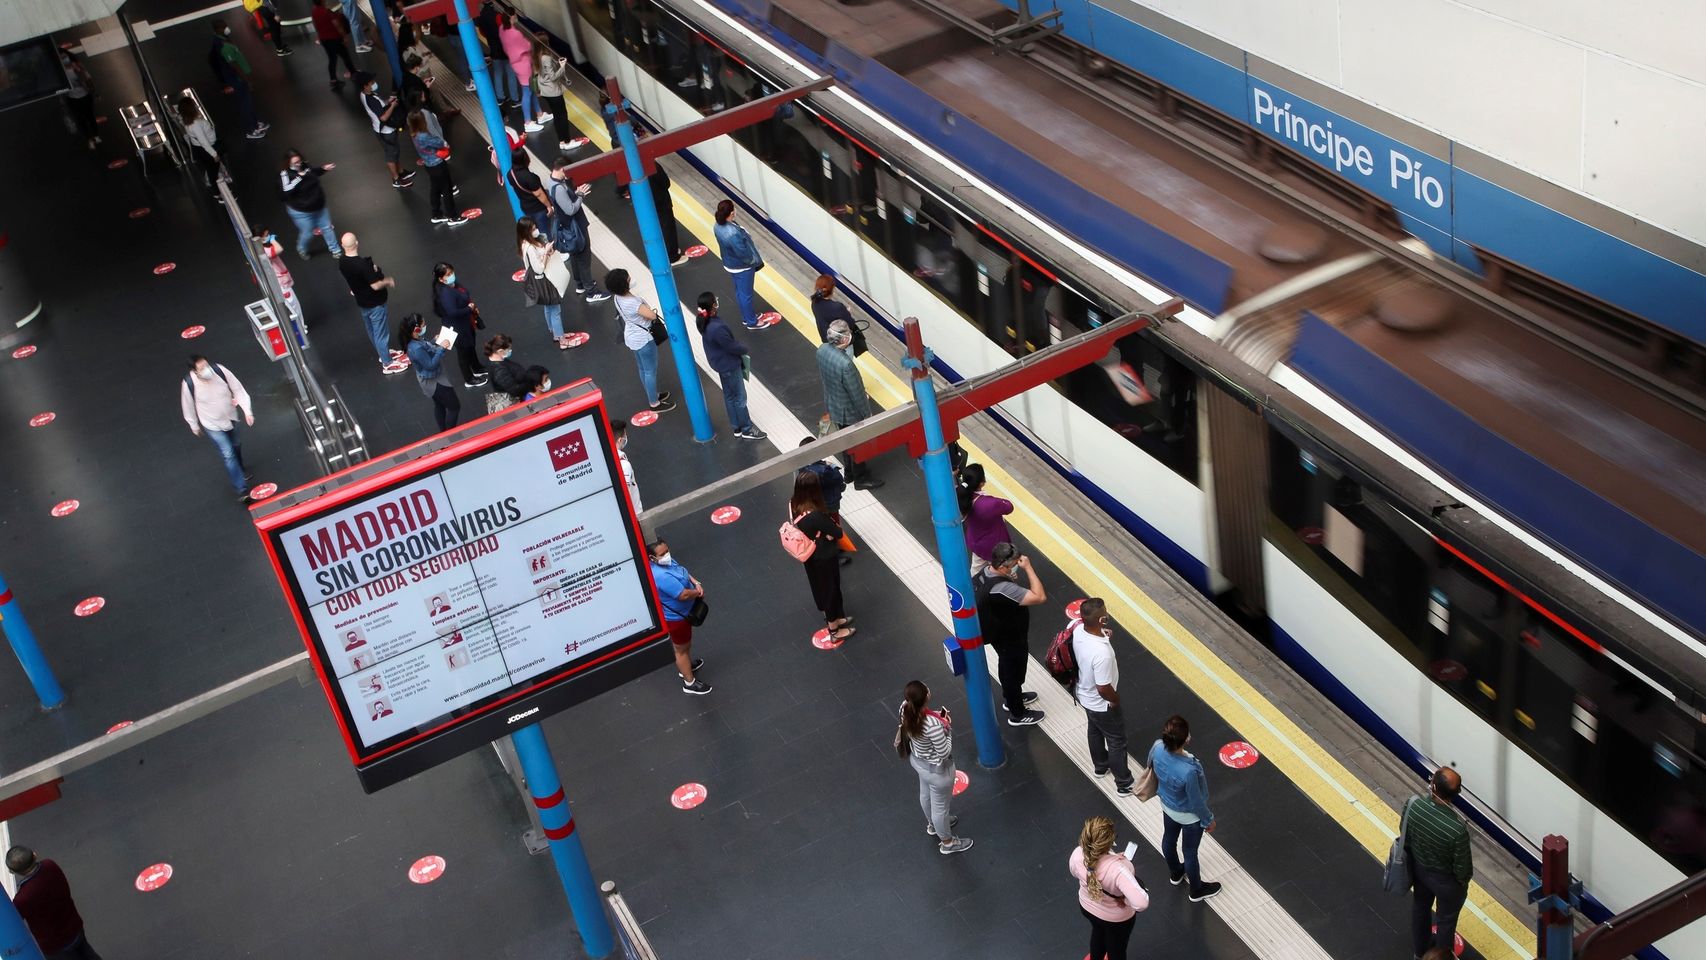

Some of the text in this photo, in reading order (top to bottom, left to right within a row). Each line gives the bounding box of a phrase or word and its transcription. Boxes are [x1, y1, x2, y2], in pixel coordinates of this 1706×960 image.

[1253, 88, 1444, 208] Príncipe Pío
[555, 461, 591, 479] Comunidad
[568, 467, 592, 480] Madrid
[299, 488, 438, 570] MADRID
[522, 525, 584, 553] POBLACIÓN VULNERABLE
[315, 496, 521, 596] SIN CORONAVIRUS
[324, 533, 499, 615] CON TODA SEGURIDAD
[532, 568, 566, 585] IMPORTANTE:
[568, 586, 587, 596] SIEMPRE
[587, 580, 602, 589] LLAMA
[542, 599, 571, 613] PREVIAMENTE
[581, 585, 602, 597] TELÉFONO
[334, 617, 357, 629] Medidas
[366, 600, 398, 617] prevención:
[431, 613, 456, 626] Limpieza
[456, 604, 478, 616] estricta:
[443, 656, 545, 702] www.comunidad.madrid/coronavirus
[507, 706, 540, 724] JCDecaux
